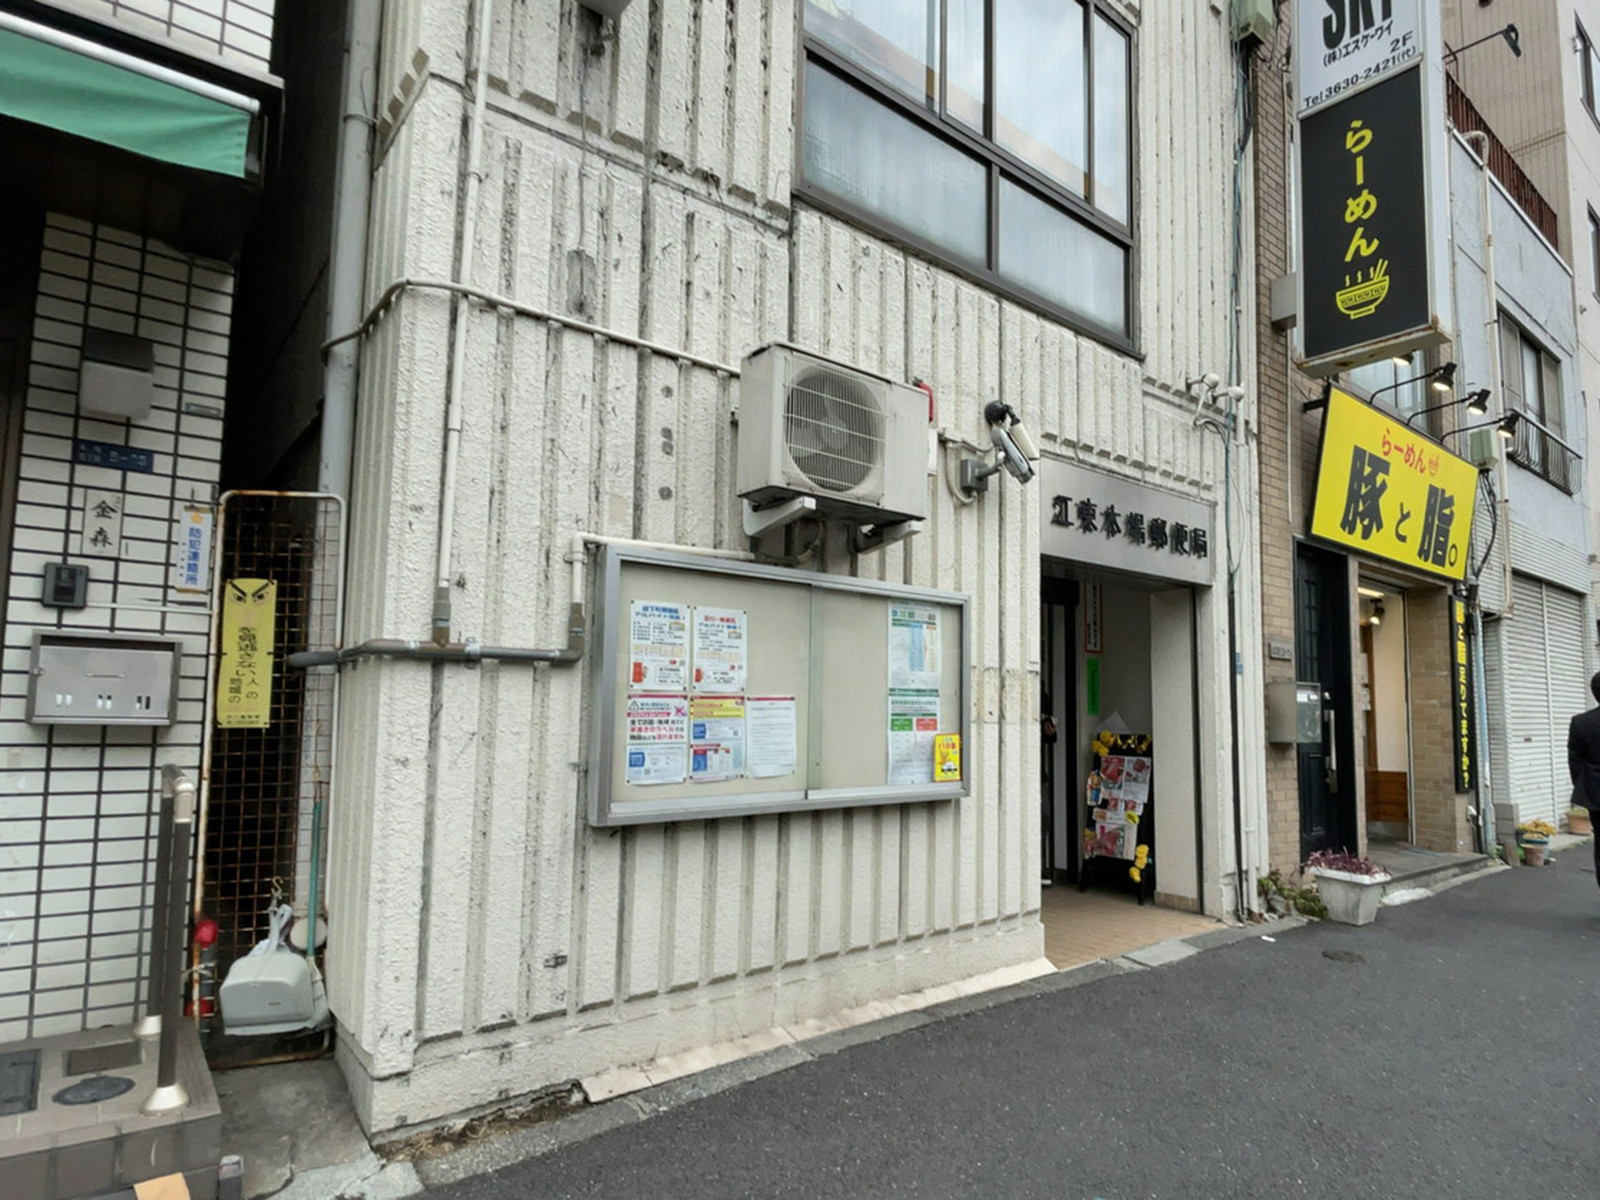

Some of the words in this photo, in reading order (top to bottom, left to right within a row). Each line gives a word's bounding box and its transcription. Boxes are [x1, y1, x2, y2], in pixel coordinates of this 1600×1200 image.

[1390, 30, 1414, 55] 2F
[1344, 119, 1380, 263] らーめん
[1381, 428, 1426, 475] らーめん
[1051, 495, 1208, 558] 江東木場郵便局
[1340, 445, 1458, 568] 豚と脂。
